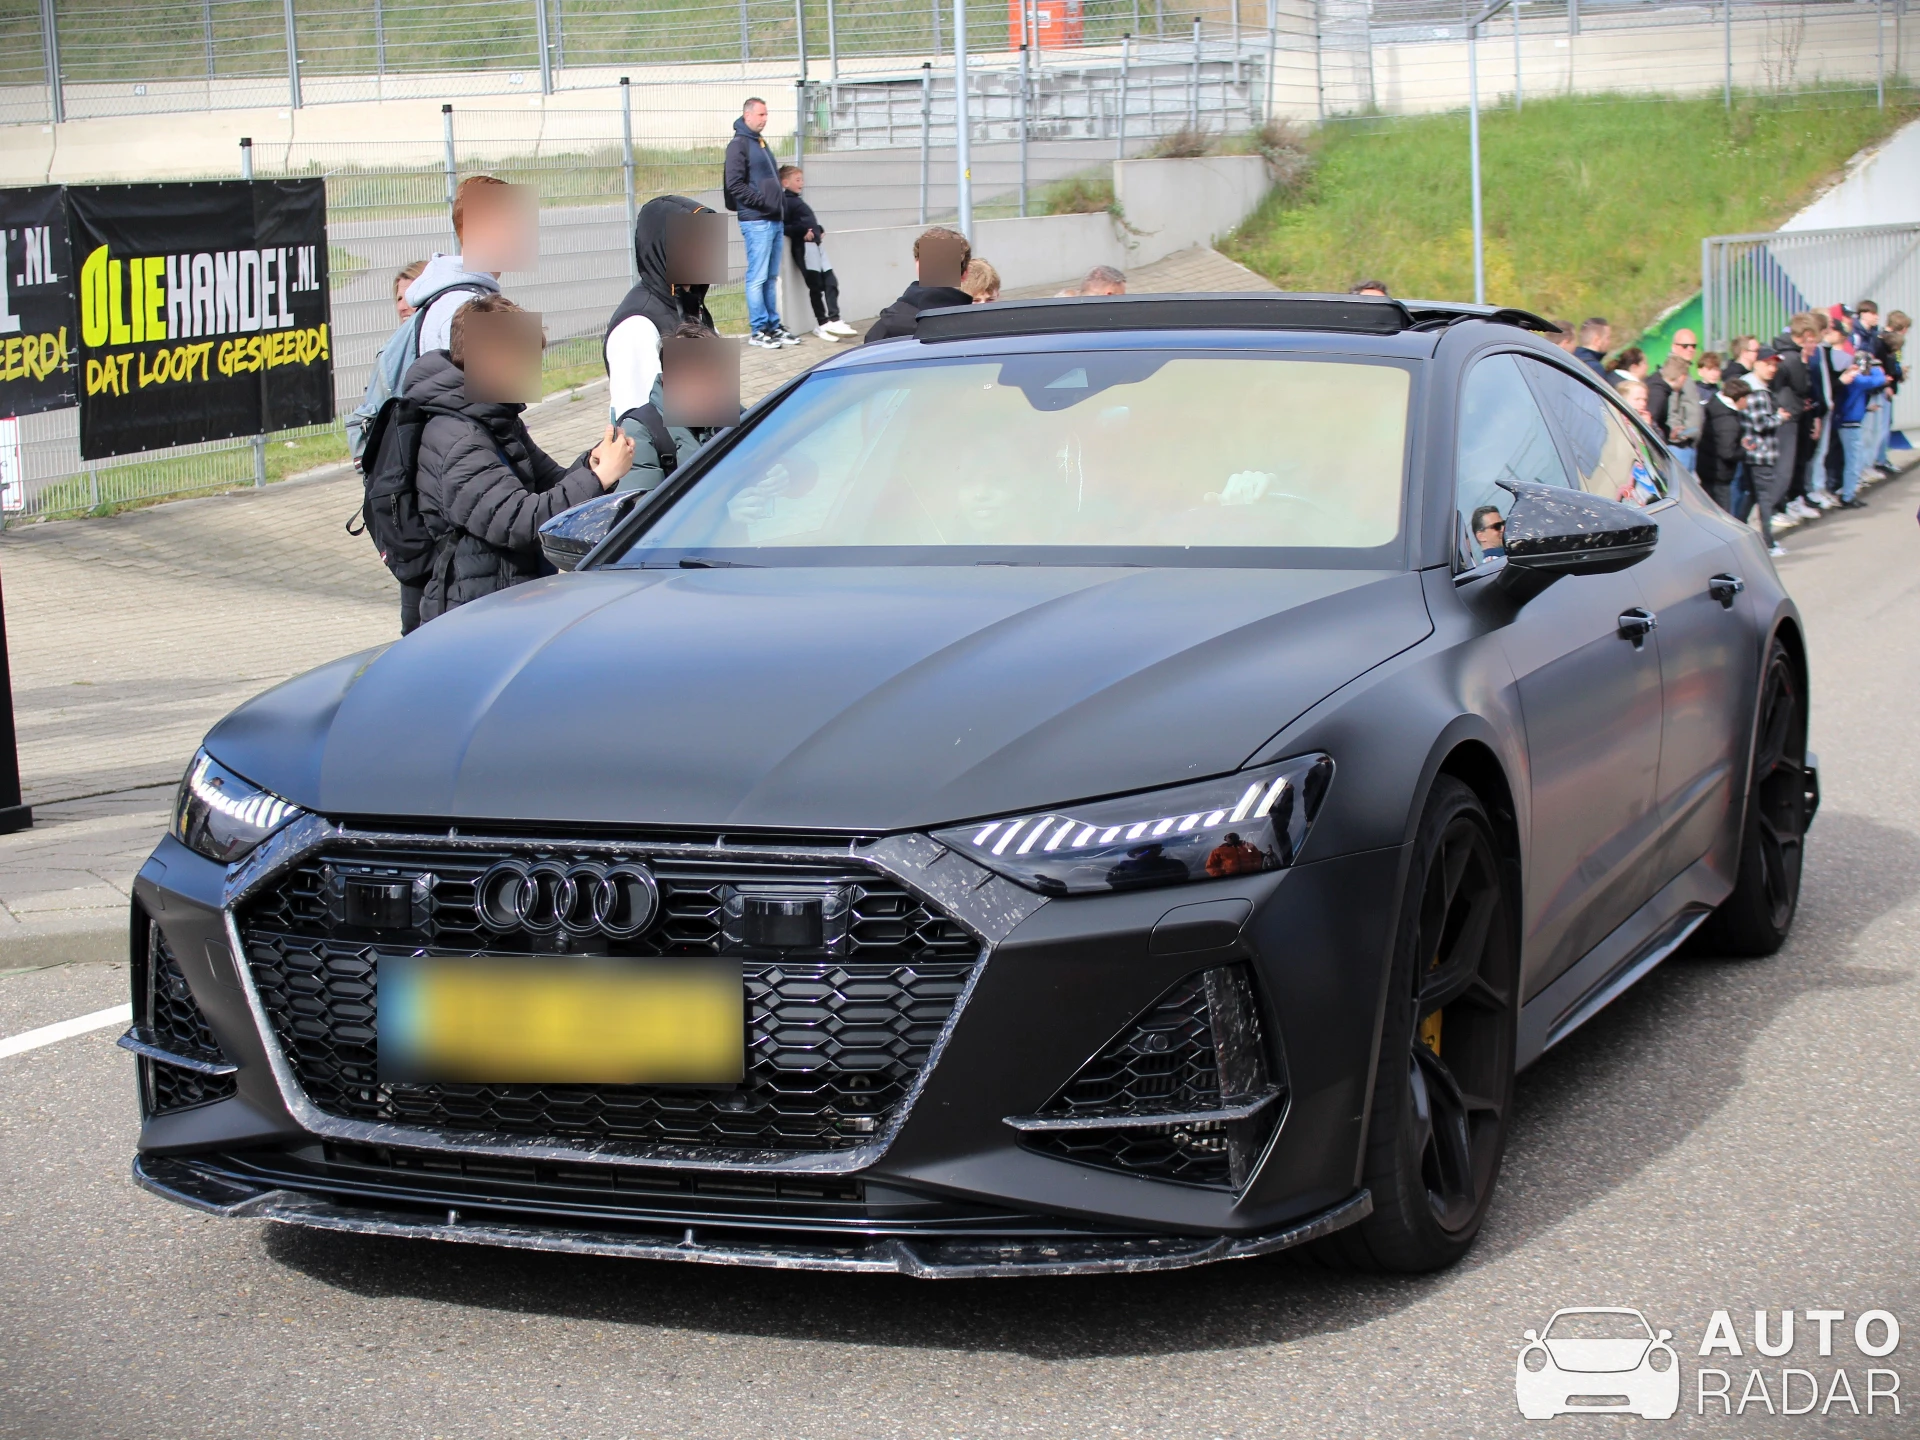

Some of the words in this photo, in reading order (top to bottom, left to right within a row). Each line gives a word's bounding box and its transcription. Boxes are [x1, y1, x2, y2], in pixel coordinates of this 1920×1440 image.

[0, 326, 69, 383] ERD!
[86, 352, 134, 397] DAT
[138, 341, 214, 389] LOOPT
[217, 323, 329, 378] GESMEERD!
